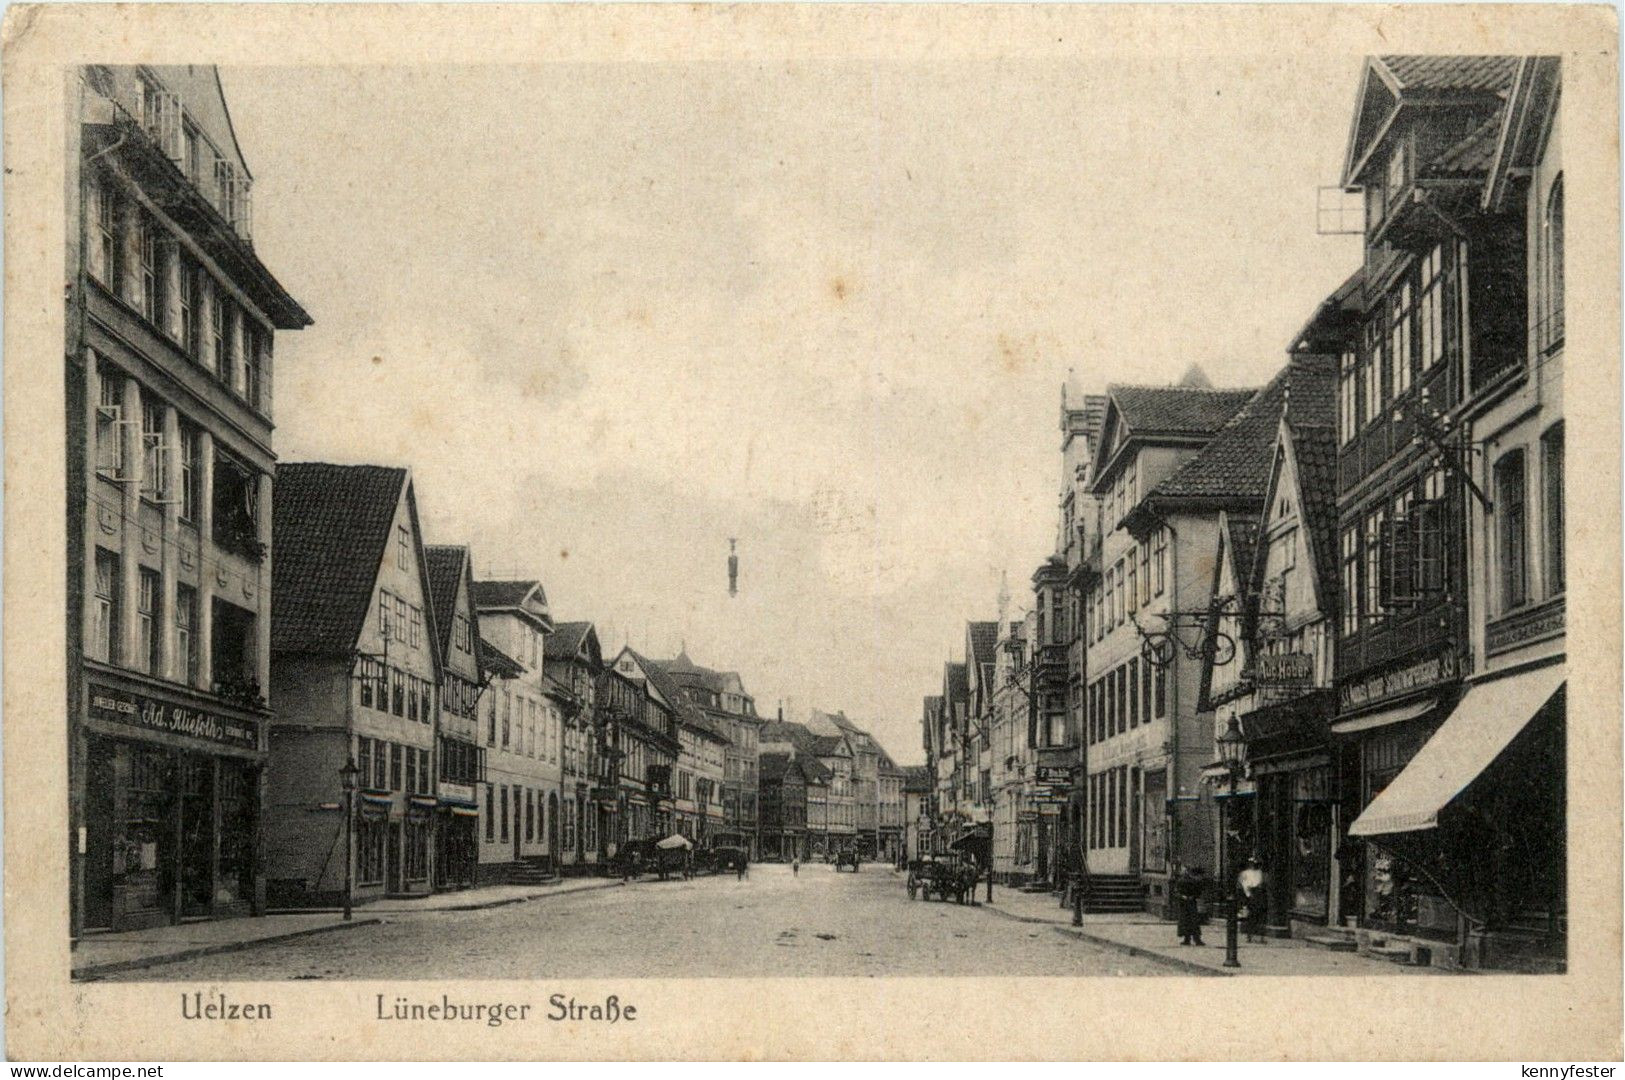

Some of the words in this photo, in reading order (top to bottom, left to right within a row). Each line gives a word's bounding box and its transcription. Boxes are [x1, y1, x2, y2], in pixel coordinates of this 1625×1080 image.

[182, 993, 272, 1020] Uelzen
[376, 994, 531, 1027] Lüneburger
[547, 994, 637, 1022] Straße
